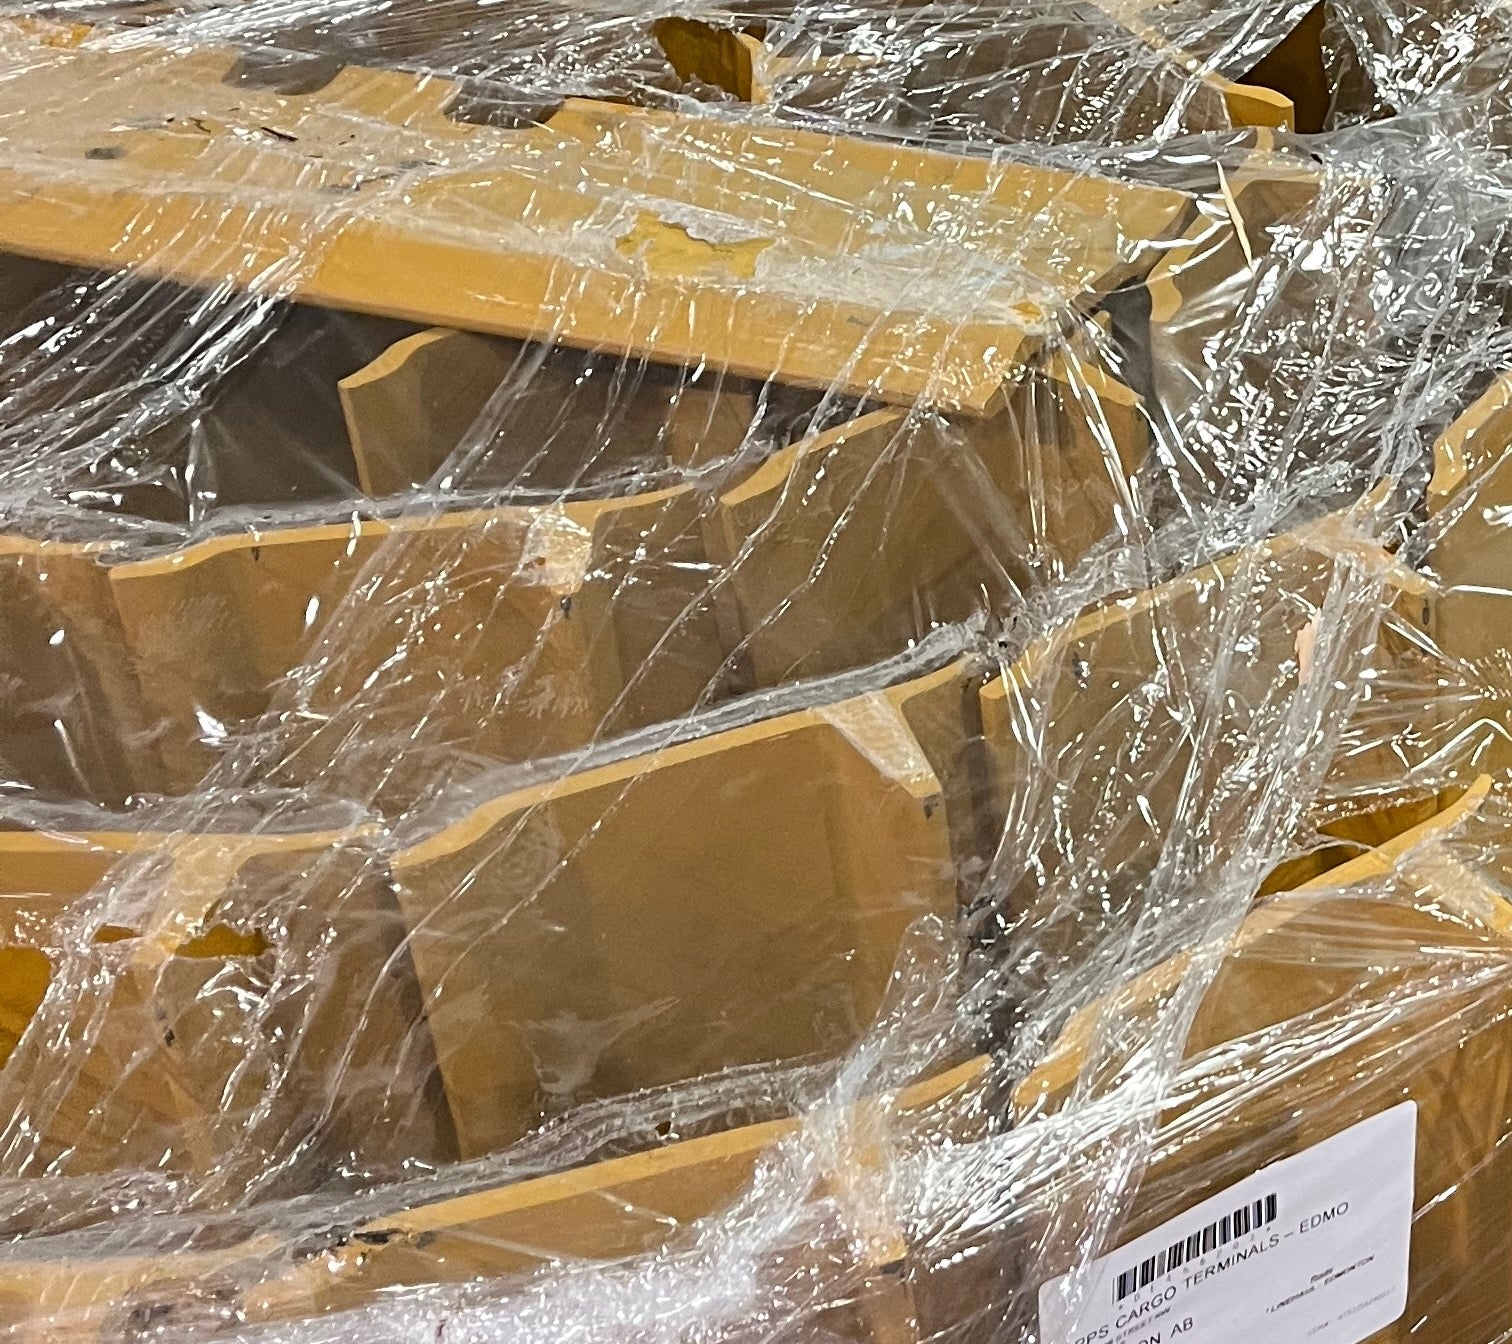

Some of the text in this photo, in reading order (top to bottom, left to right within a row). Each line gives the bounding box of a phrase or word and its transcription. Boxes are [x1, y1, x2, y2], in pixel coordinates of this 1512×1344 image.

[1115, 1286, 1177, 1329] CARGO
[1183, 1233, 1281, 1291] TERMINALS
[1298, 1201, 1349, 1235] EDMO
[1170, 1317, 1194, 1338] AB
